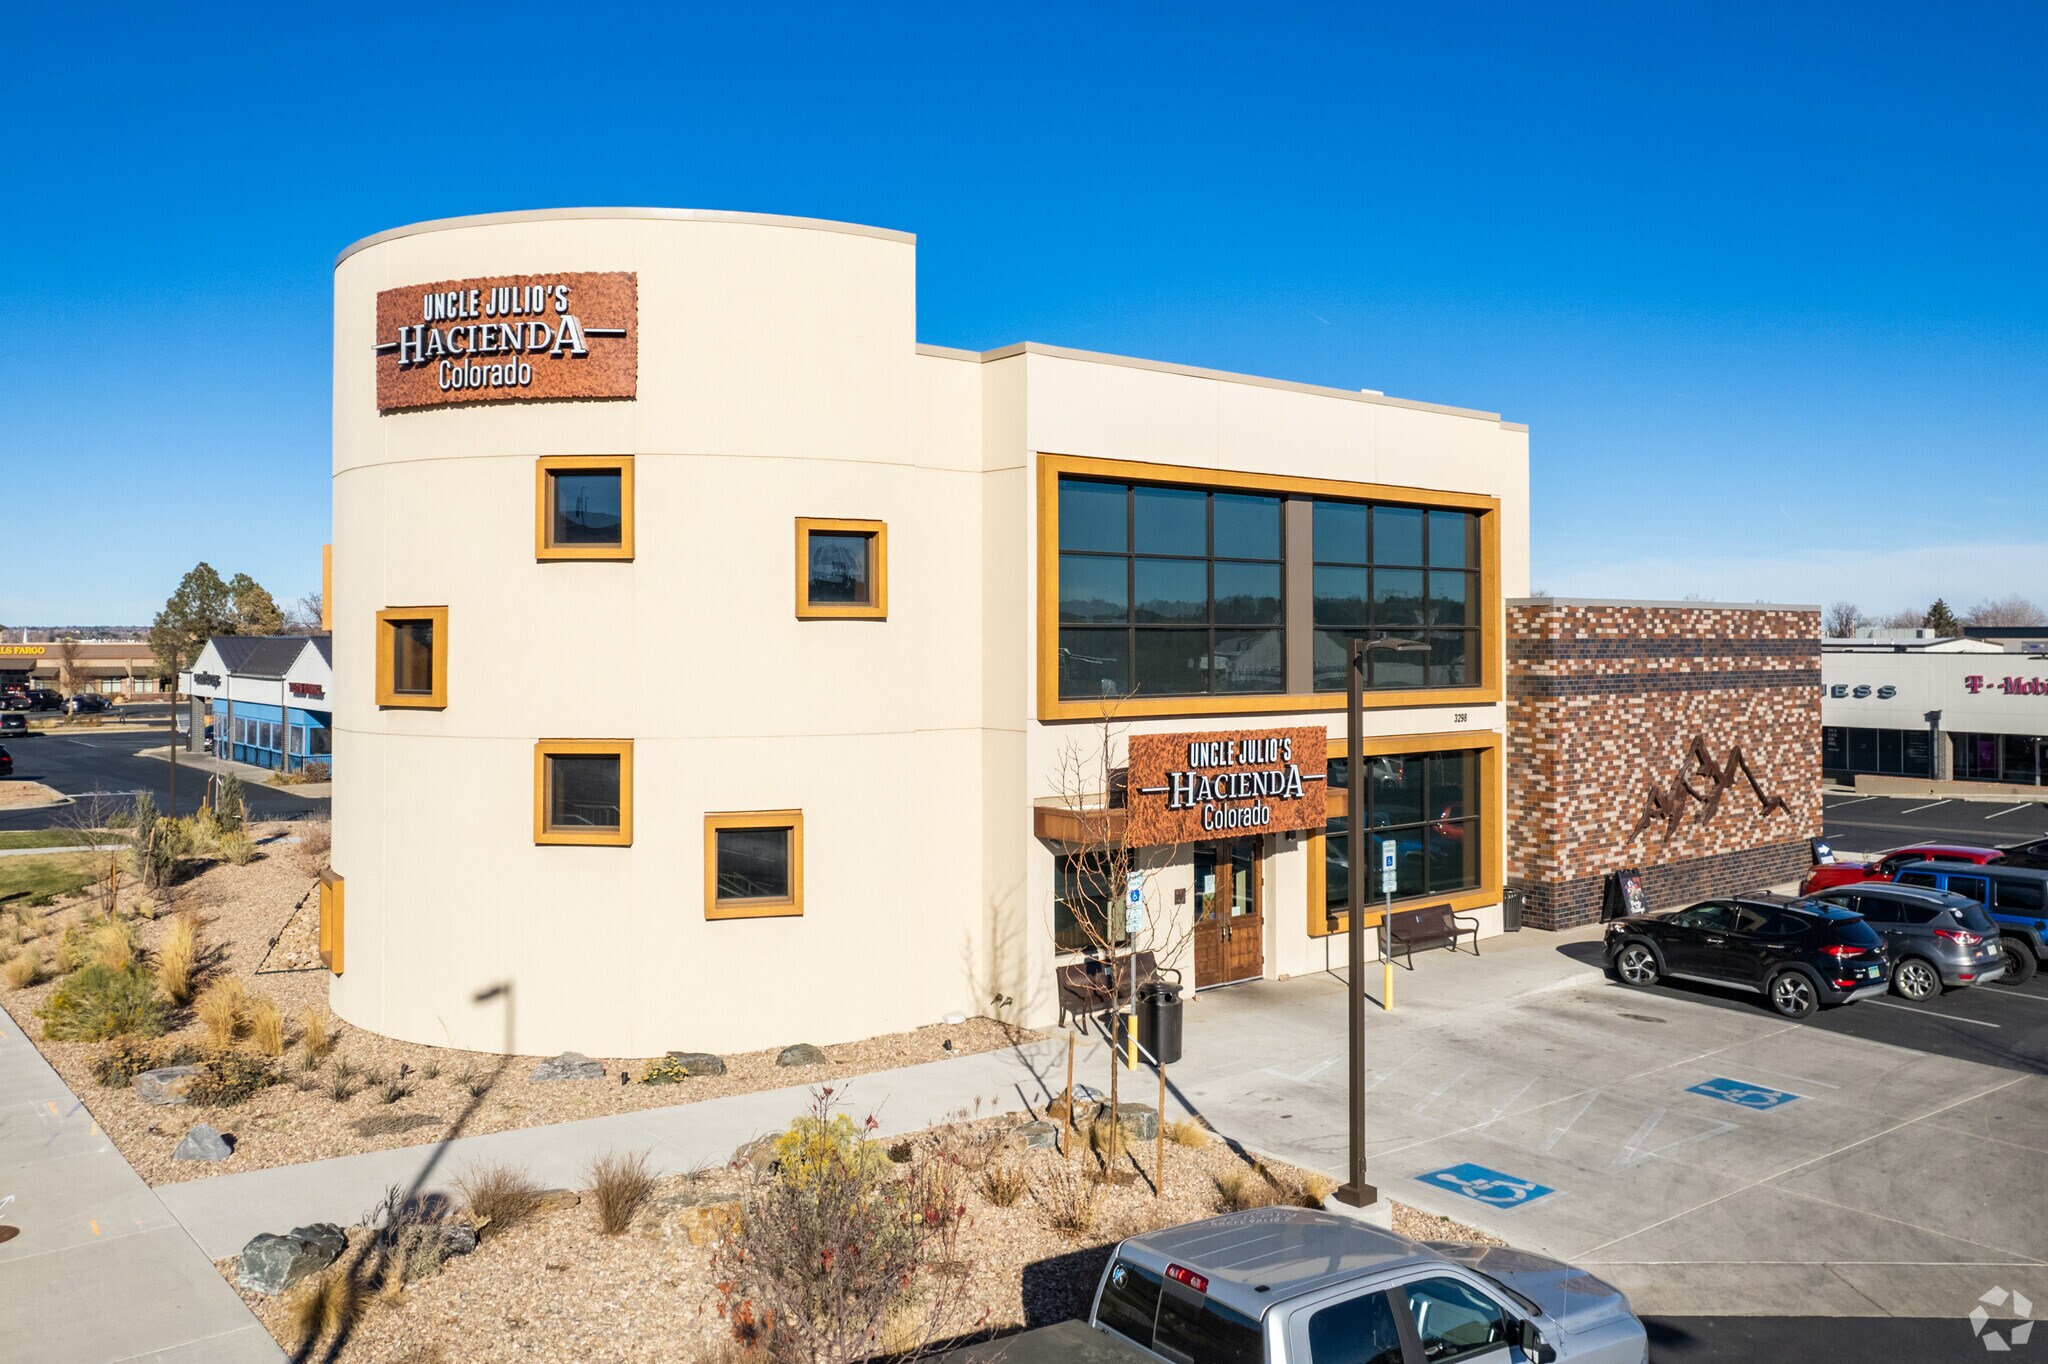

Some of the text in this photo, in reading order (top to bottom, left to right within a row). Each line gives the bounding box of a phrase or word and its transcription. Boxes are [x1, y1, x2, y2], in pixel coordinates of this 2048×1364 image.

[423, 284, 570, 321] UNCLE JULIO'S
[397, 315, 589, 365] HACIENDA
[439, 356, 532, 390] Colorado
[14, 646, 46, 655] FARGO
[1454, 713, 1468, 723] 3298
[1190, 737, 1292, 768] UNCLE JULIO'S
[1170, 763, 1306, 809] HACIENDA
[1203, 800, 1270, 831] Colorado
